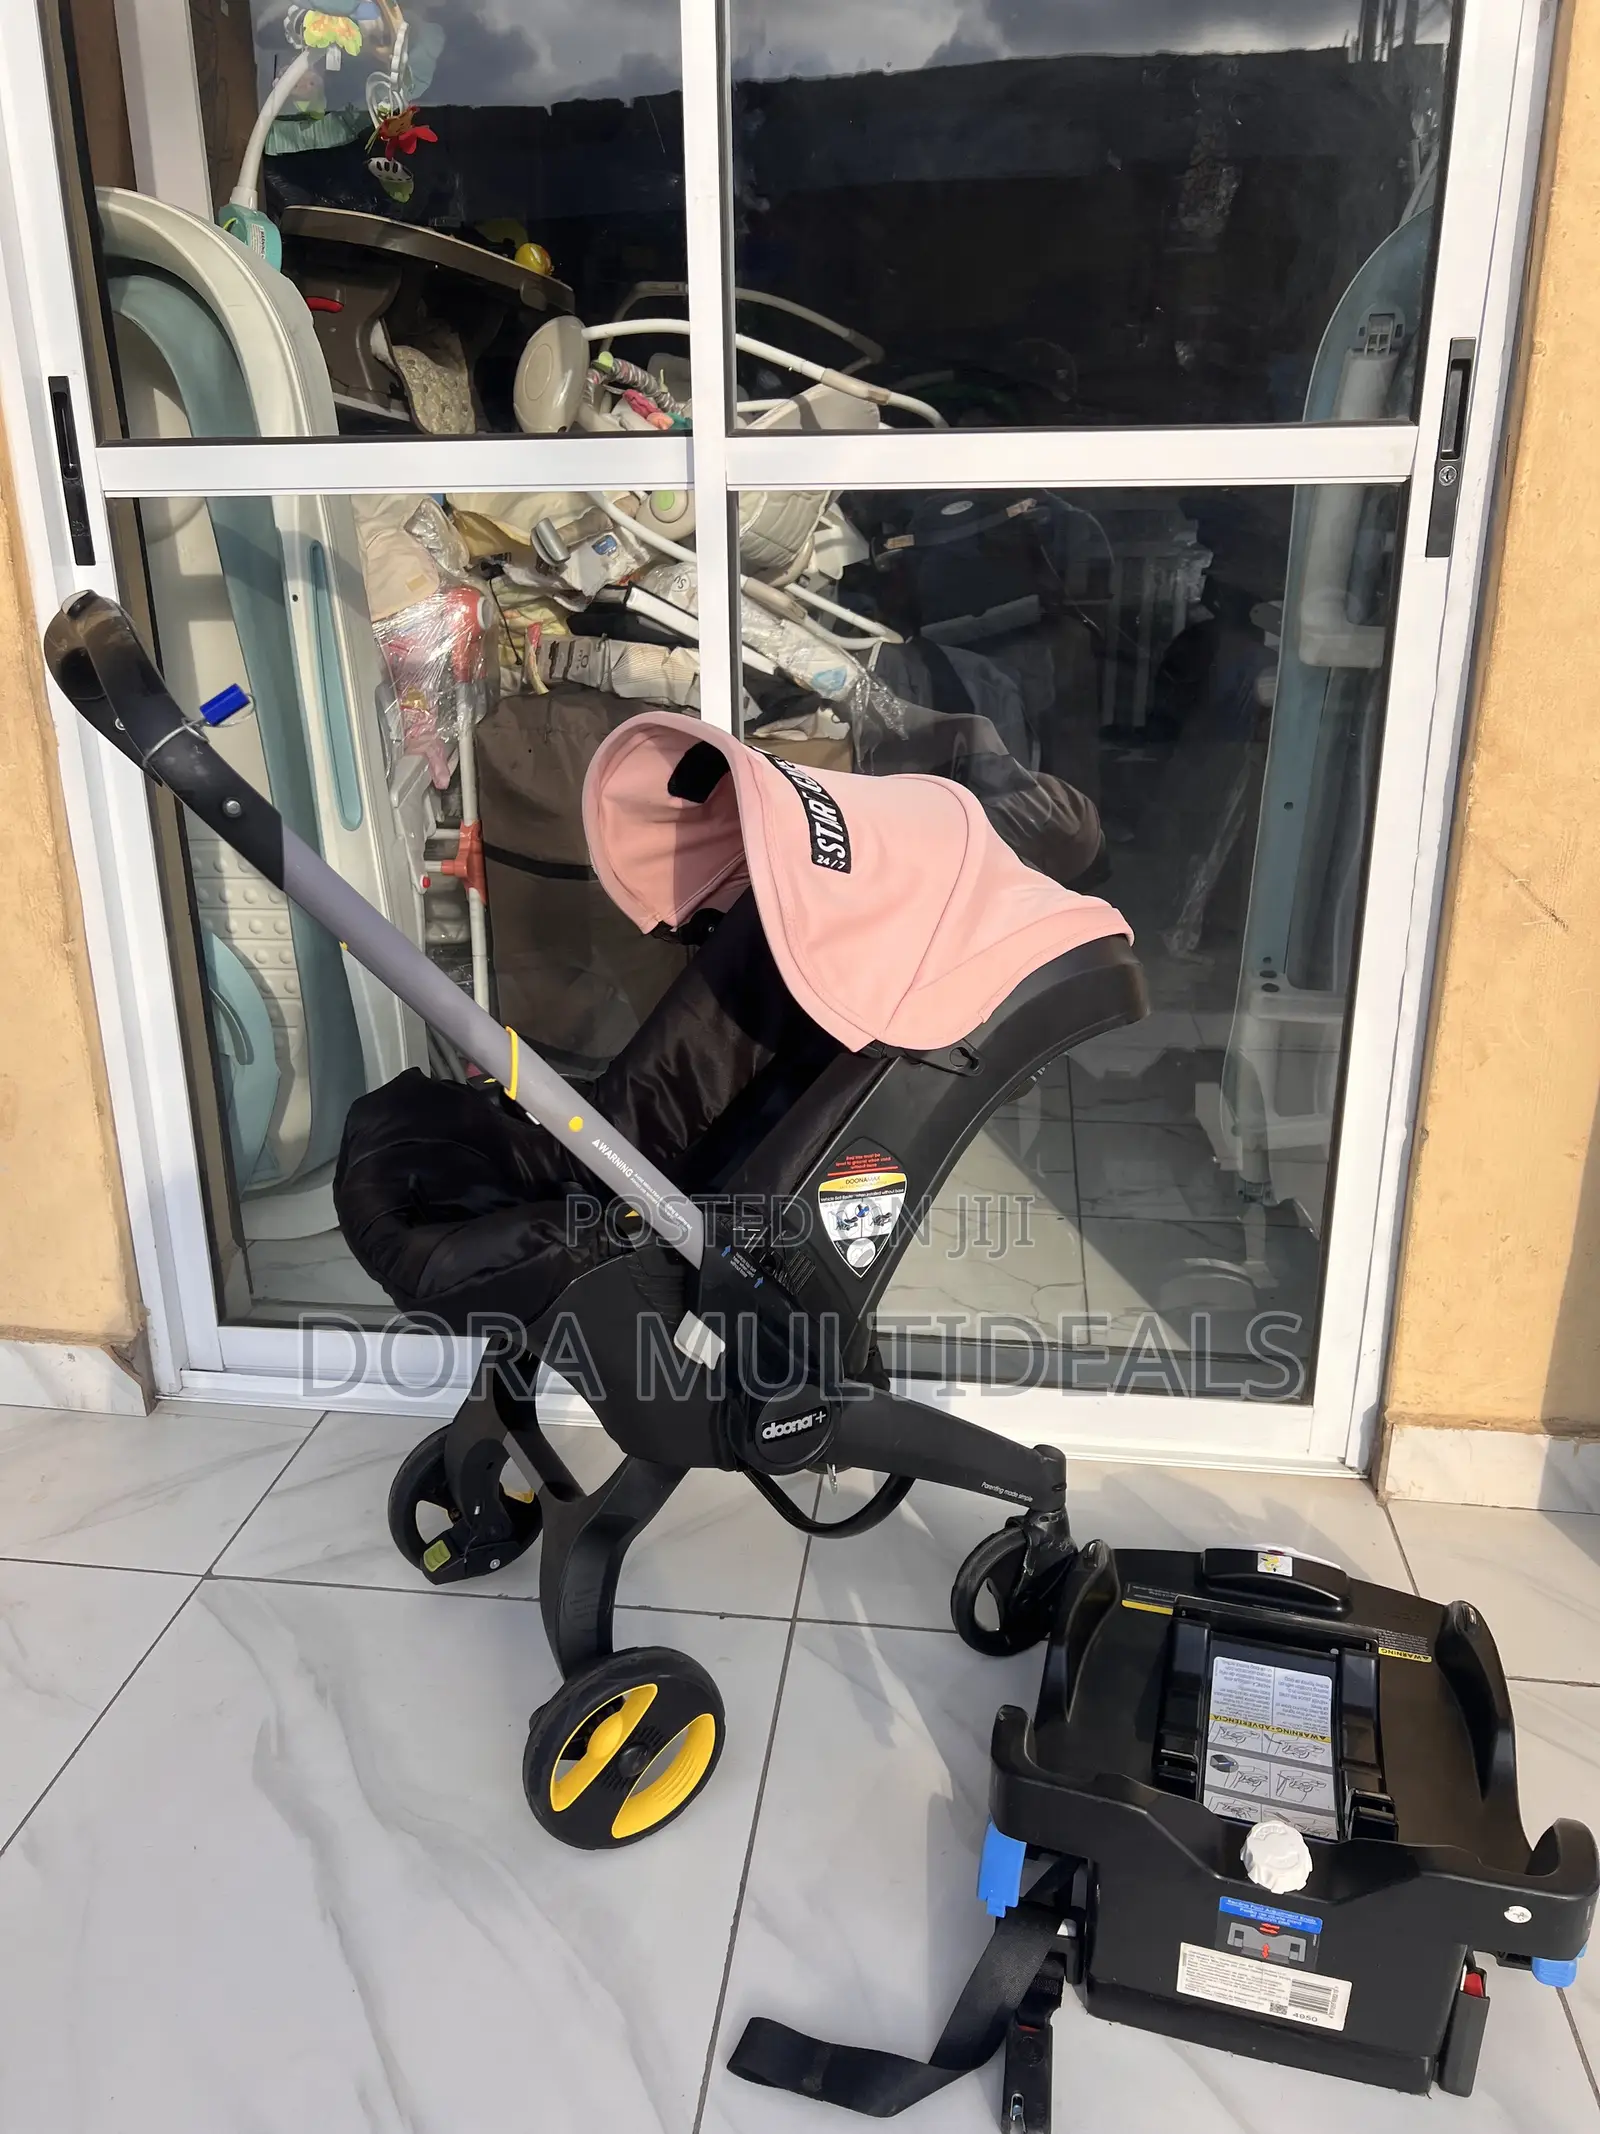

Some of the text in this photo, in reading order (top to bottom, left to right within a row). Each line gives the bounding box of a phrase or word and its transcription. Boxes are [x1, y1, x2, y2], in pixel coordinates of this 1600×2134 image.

[817, 855, 845, 869] 24/7
[599, 1142, 633, 1177] WARNING
[981, 1481, 1033, 1502] Parenting made simple
[1381, 1648, 1422, 1660] WARNING
[1276, 1728, 1320, 1740] WARNING
